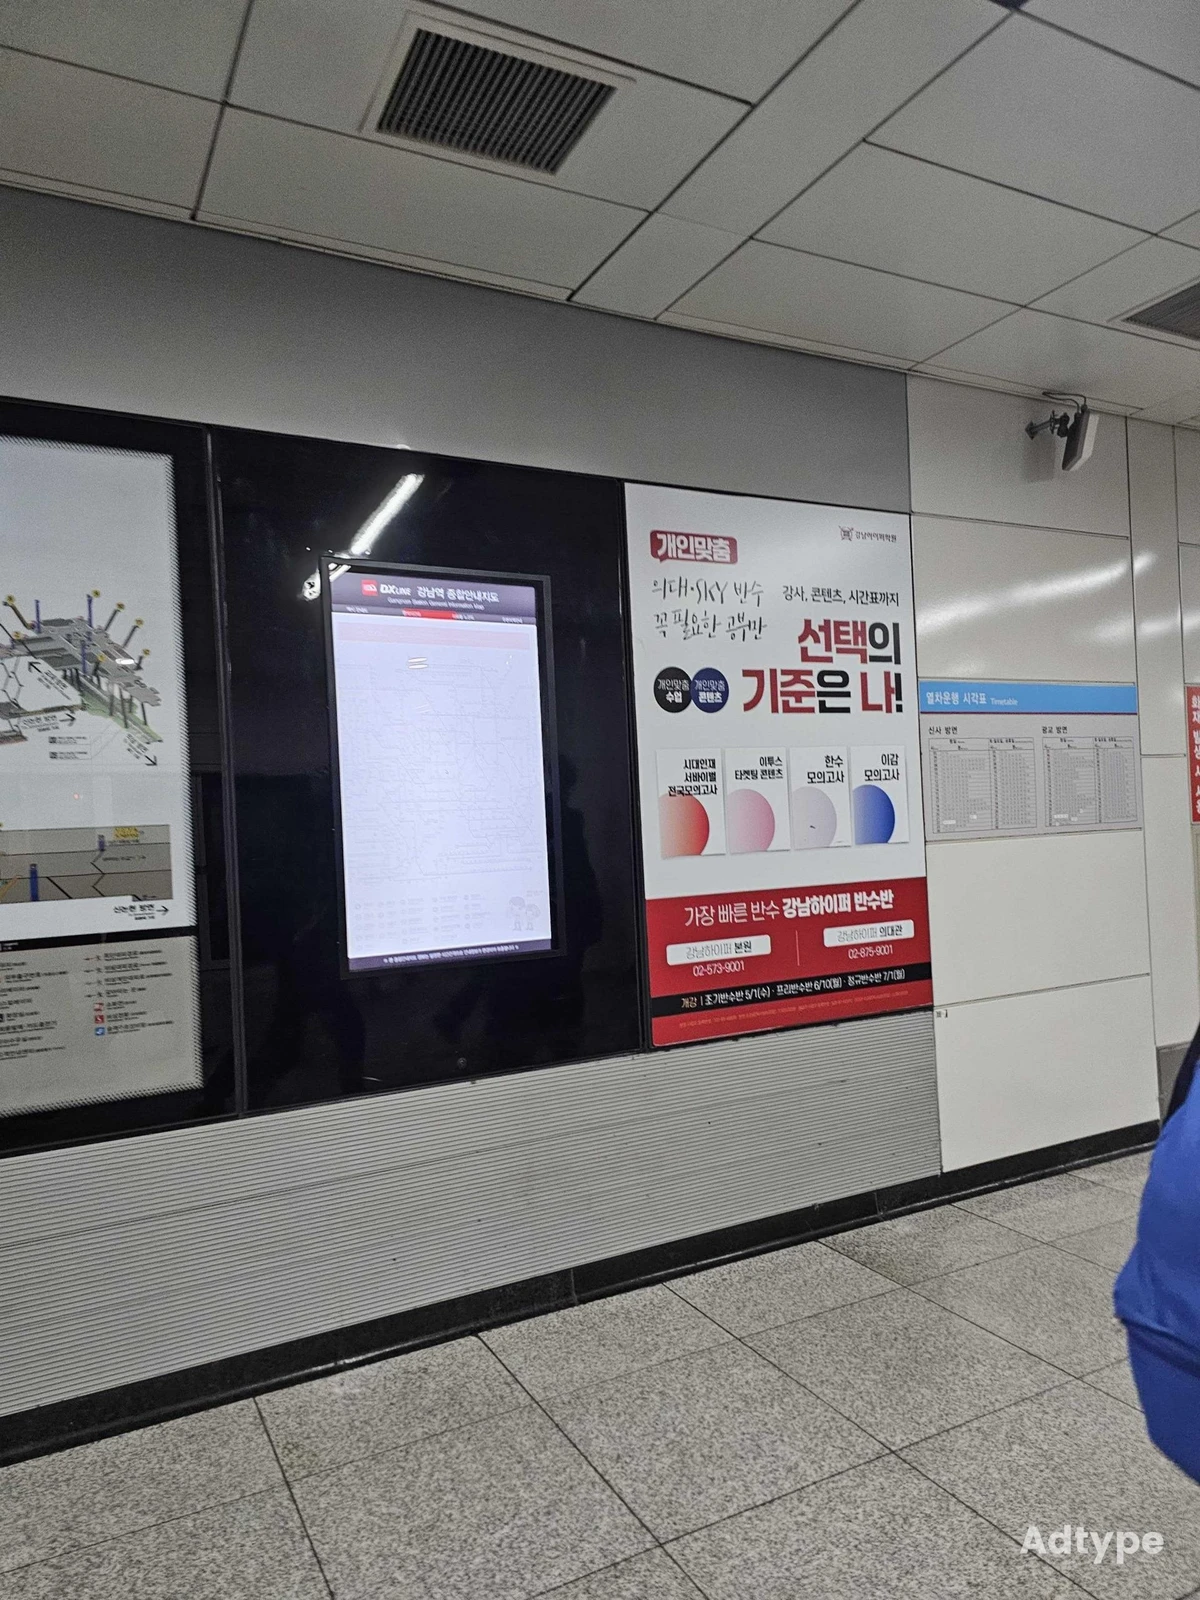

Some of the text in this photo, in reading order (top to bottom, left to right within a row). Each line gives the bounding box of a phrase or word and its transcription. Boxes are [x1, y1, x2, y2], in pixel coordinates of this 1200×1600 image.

[656, 532, 731, 563] 개인맞춤
[416, 586, 445, 600] 강남역
[734, 581, 764, 607] 반수
[783, 585, 899, 607] 강사, 콘텐츠, 시간표까지
[653, 609, 768, 643] 꼭 필요한 공부만
[797, 618, 902, 665] 선택의
[657, 679, 690, 692] 개인맞춤
[694, 679, 726, 692] 개인맞춤
[741, 668, 903, 714] 기준은 나!
[665, 691, 683, 703] 수업
[698, 691, 723, 704] 콘텐츠
[926, 691, 987, 705] 열차운행 시각표
[990, 697, 1018, 706] Timetable
[928, 726, 958, 735] 신사 방면
[1056, 726, 1068, 734] 방면
[683, 758, 716, 771] 시대인재
[759, 756, 783, 768] 이투스
[824, 755, 844, 768] 한수
[881, 753, 899, 766] 이감
[684, 771, 717, 783] 서바이벌
[760, 769, 784, 780] 콘텐츠
[807, 771, 845, 784] 모의고사
[864, 769, 900, 782] 모의고사
[668, 785, 718, 797] 전국모의고사
[684, 889, 895, 927] 가장 빠른 반수 강남하이퍼 반수반
[879, 924, 903, 937] 의대관
[686, 940, 752, 960] 강남하이퍼 본원
[848, 945, 893, 959] 02-875-9001
[693, 960, 745, 977] 02-573-9001
